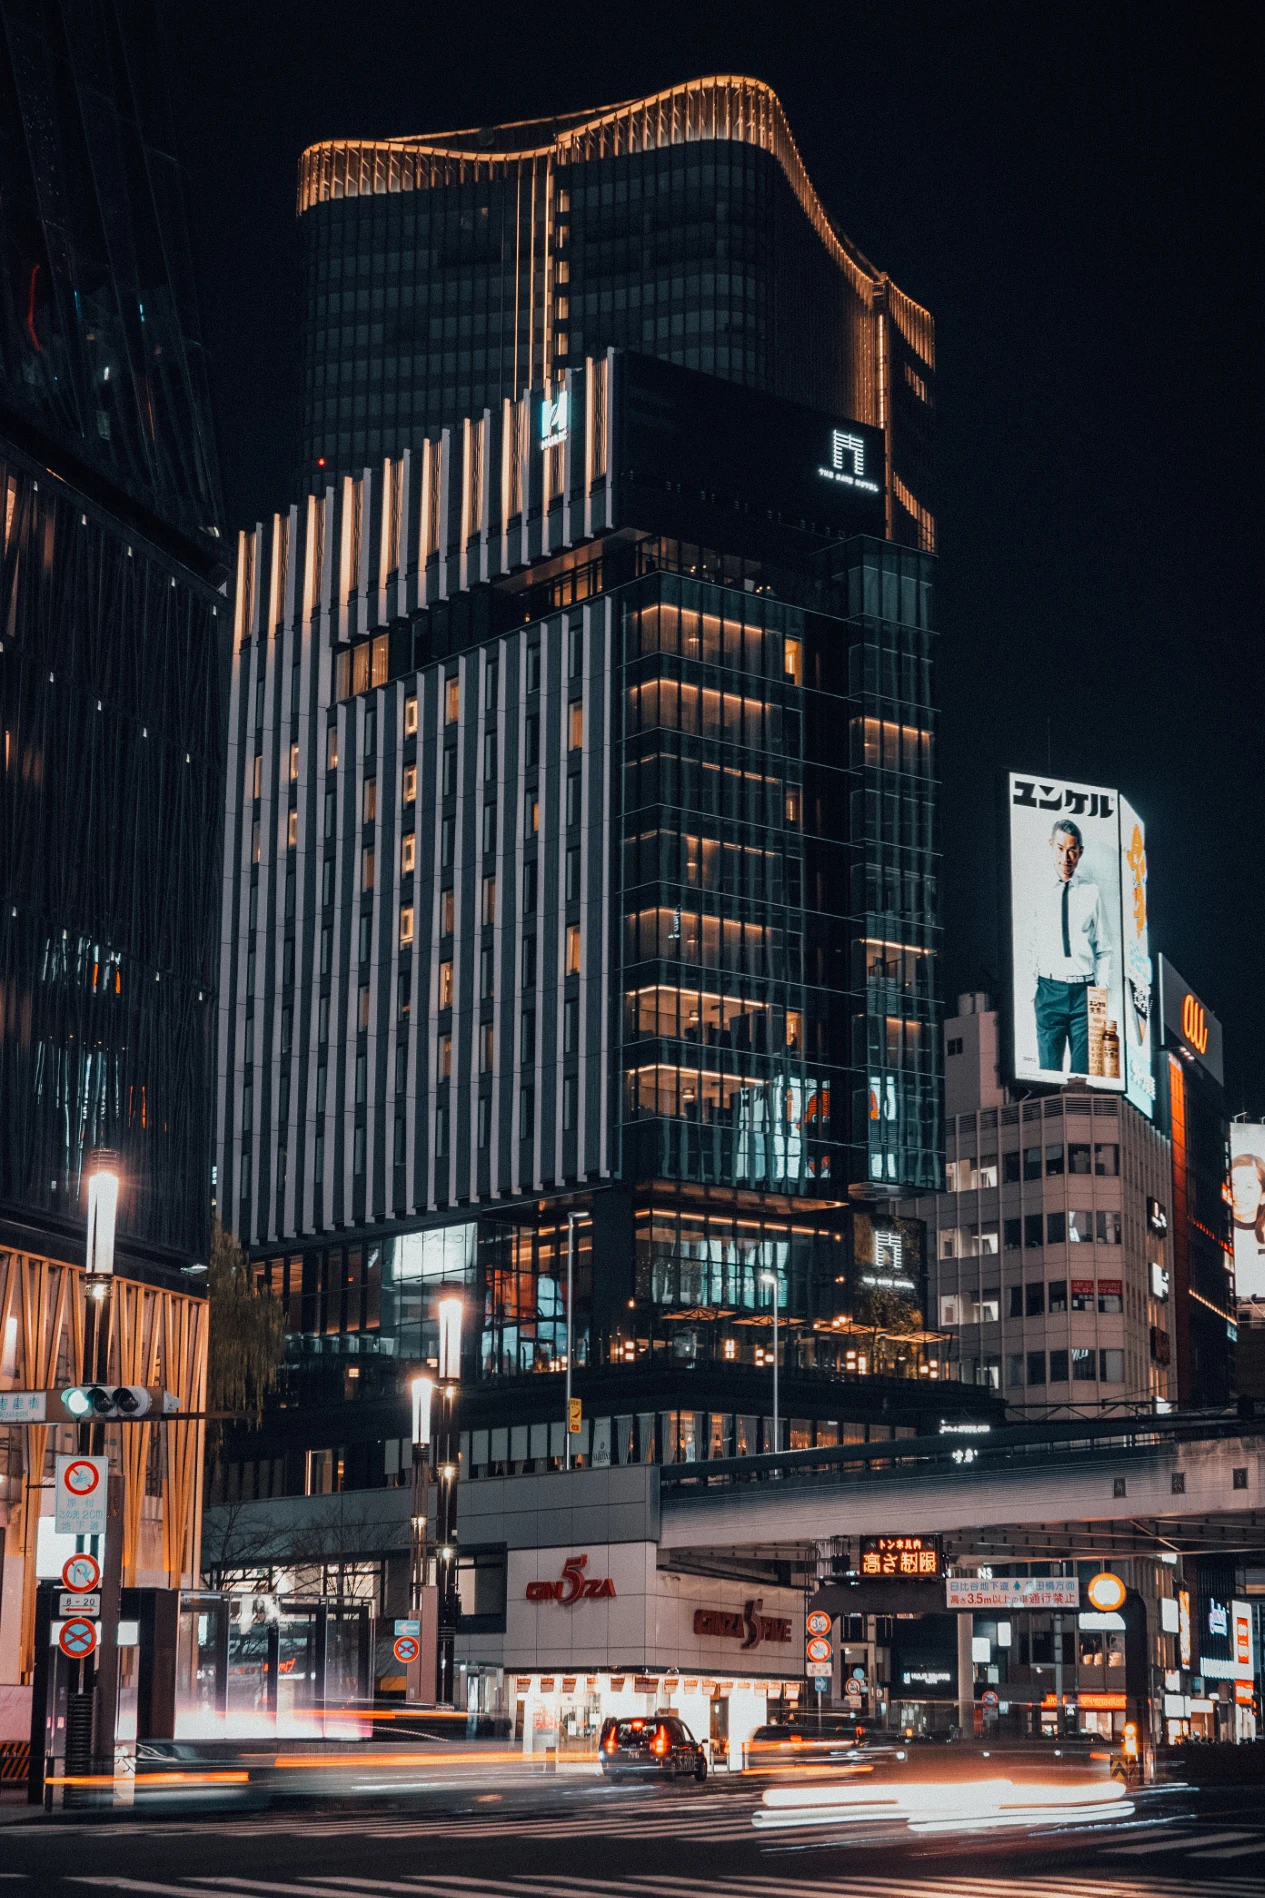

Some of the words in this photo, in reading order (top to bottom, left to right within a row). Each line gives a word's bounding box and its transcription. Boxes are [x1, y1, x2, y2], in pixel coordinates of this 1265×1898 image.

[818, 468, 834, 479] THE
[854, 479, 879, 492] HOTEL
[1013, 781, 1114, 818] ユンケル
[863, 1552, 936, 1573] 高さ制限
[950, 1581, 1009, 1591] 日比谷地下道
